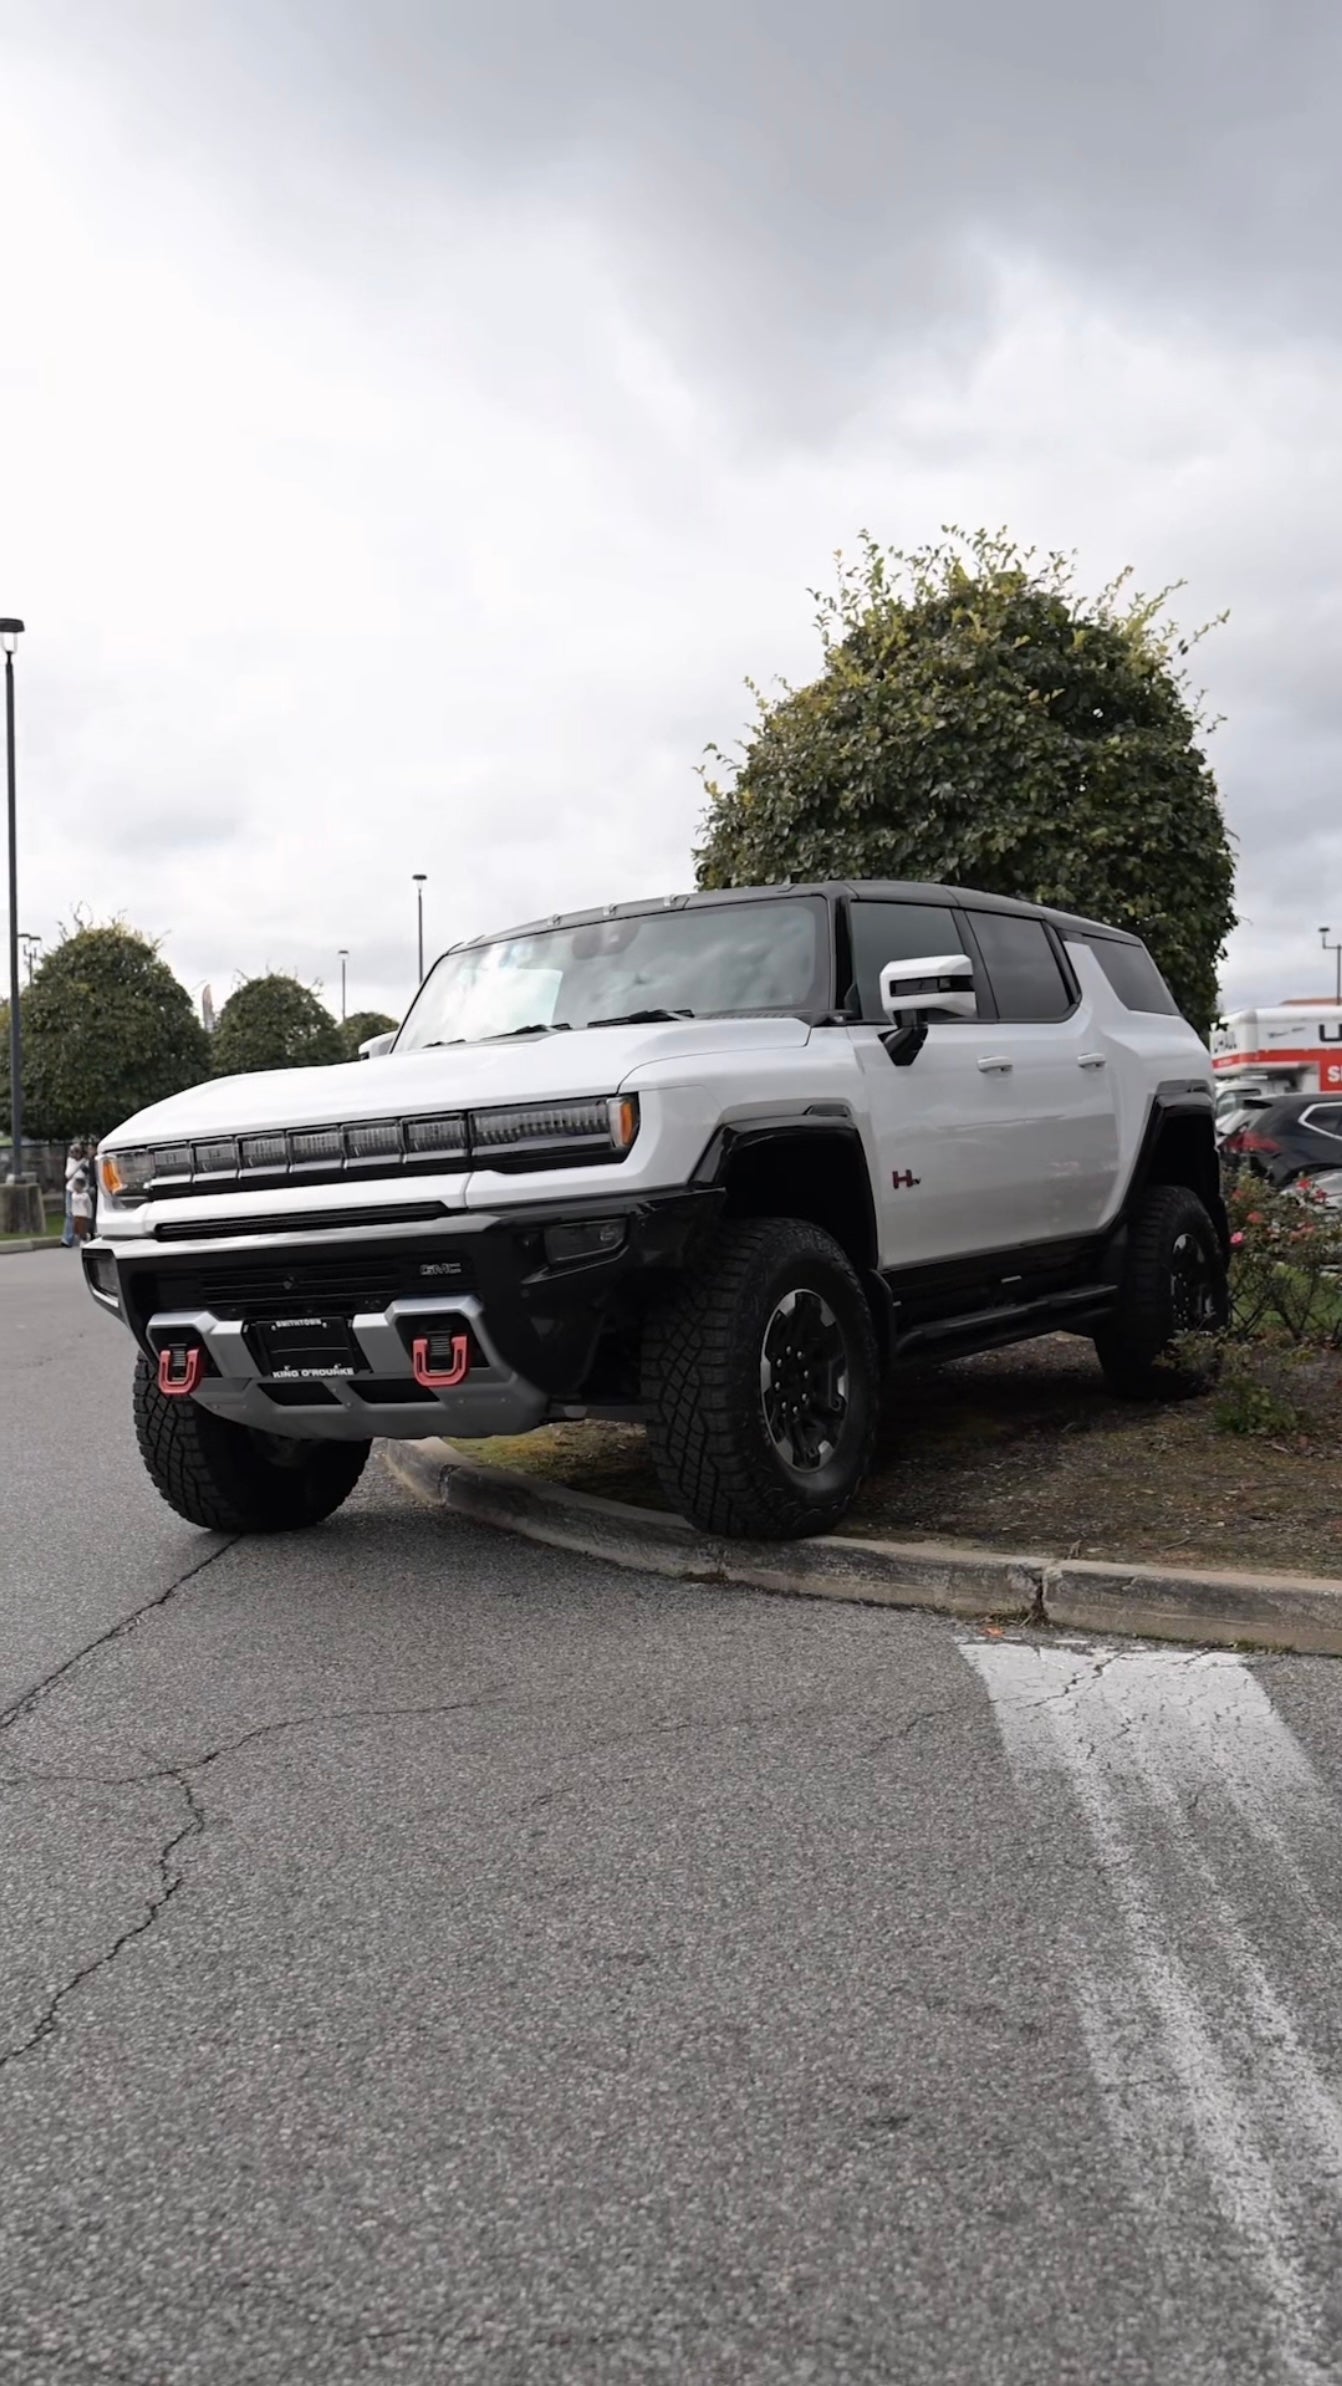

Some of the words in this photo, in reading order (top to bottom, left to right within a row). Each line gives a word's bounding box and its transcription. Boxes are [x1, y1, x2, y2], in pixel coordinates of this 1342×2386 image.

[420, 1262, 462, 1276] GMC
[272, 1370, 300, 1379] KING
[301, 1367, 355, 1378] O'ROURKE
